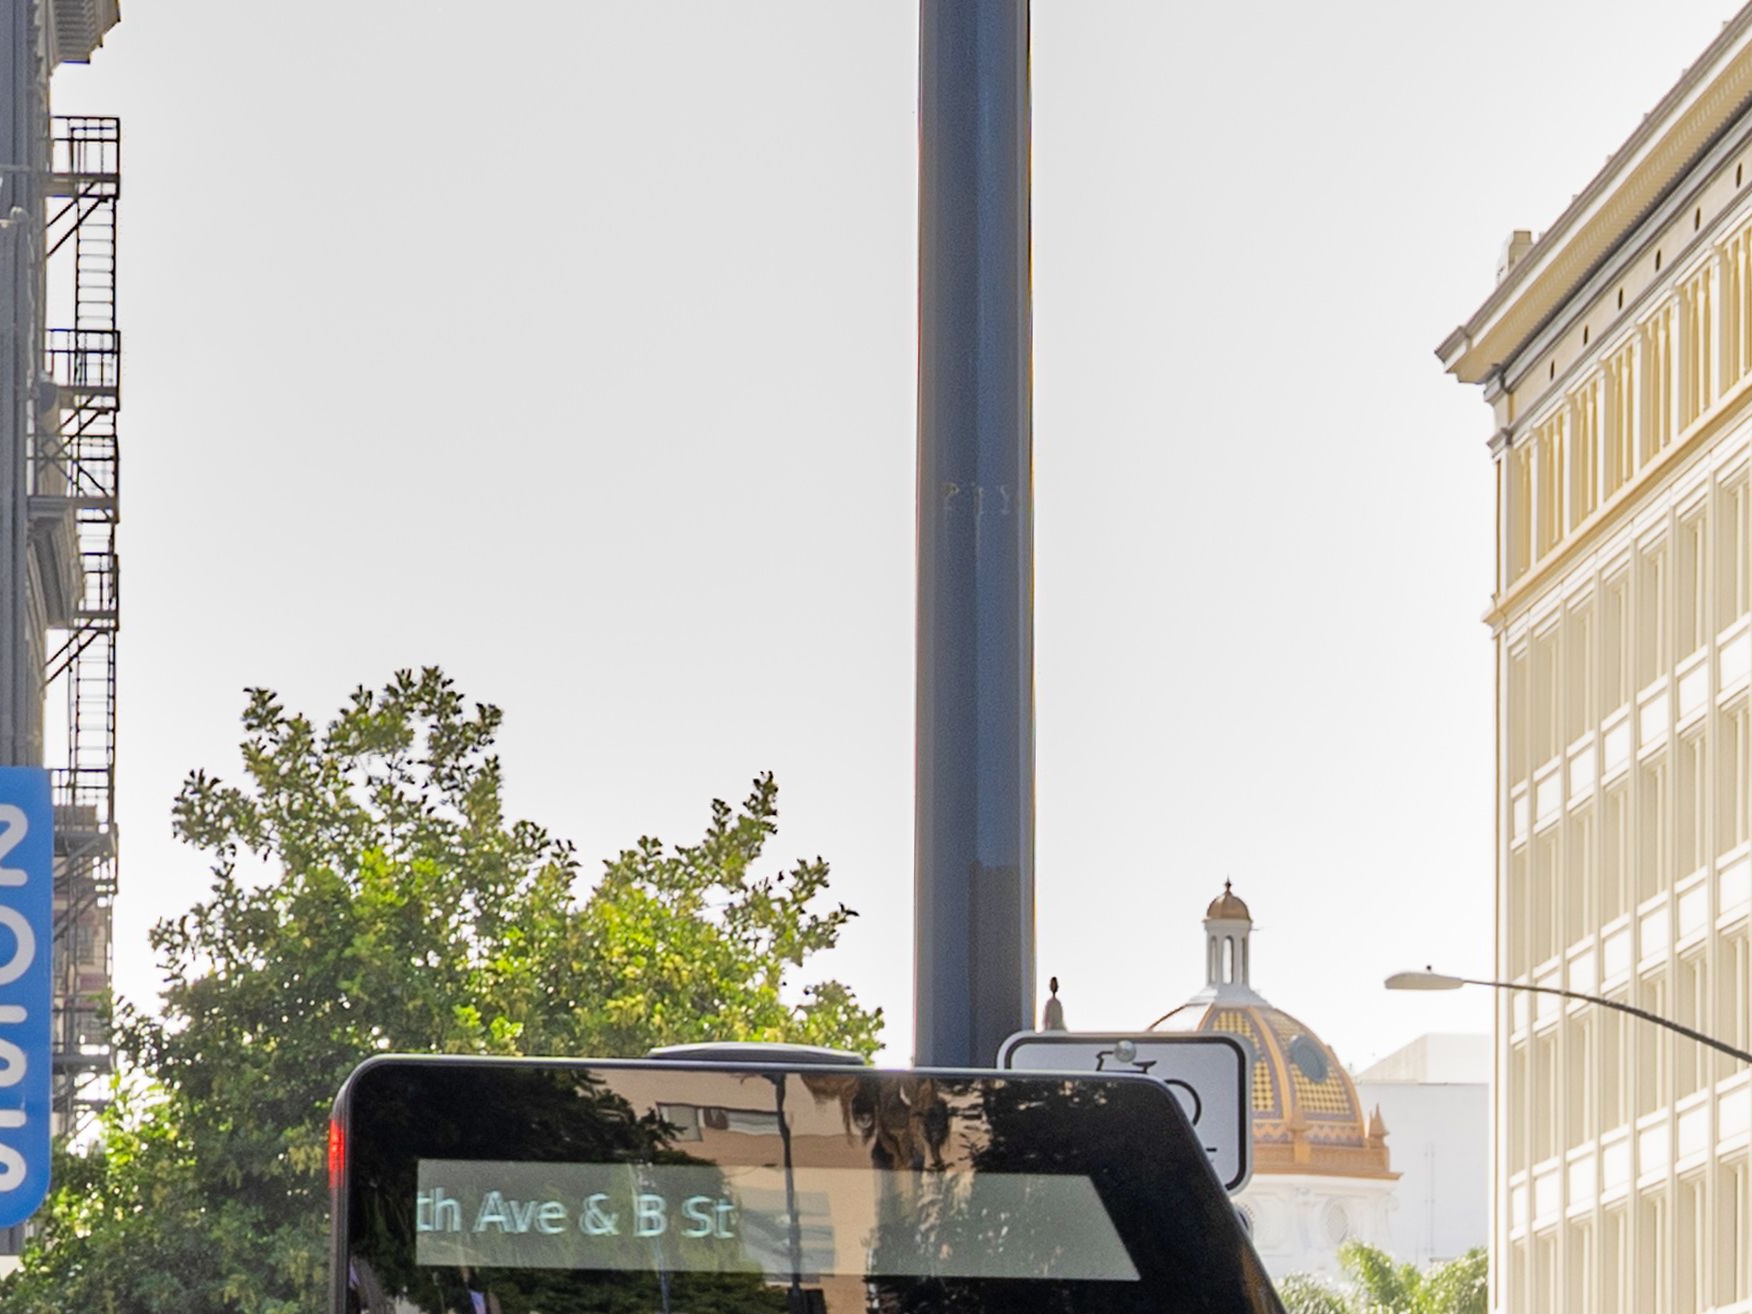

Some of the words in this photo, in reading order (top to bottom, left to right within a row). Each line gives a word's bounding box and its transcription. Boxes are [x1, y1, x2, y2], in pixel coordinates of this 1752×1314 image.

[473, 1190, 568, 1234] Ave
[579, 1192, 620, 1236] &
[633, 1194, 669, 1238] B
[681, 1195, 736, 1240] St
